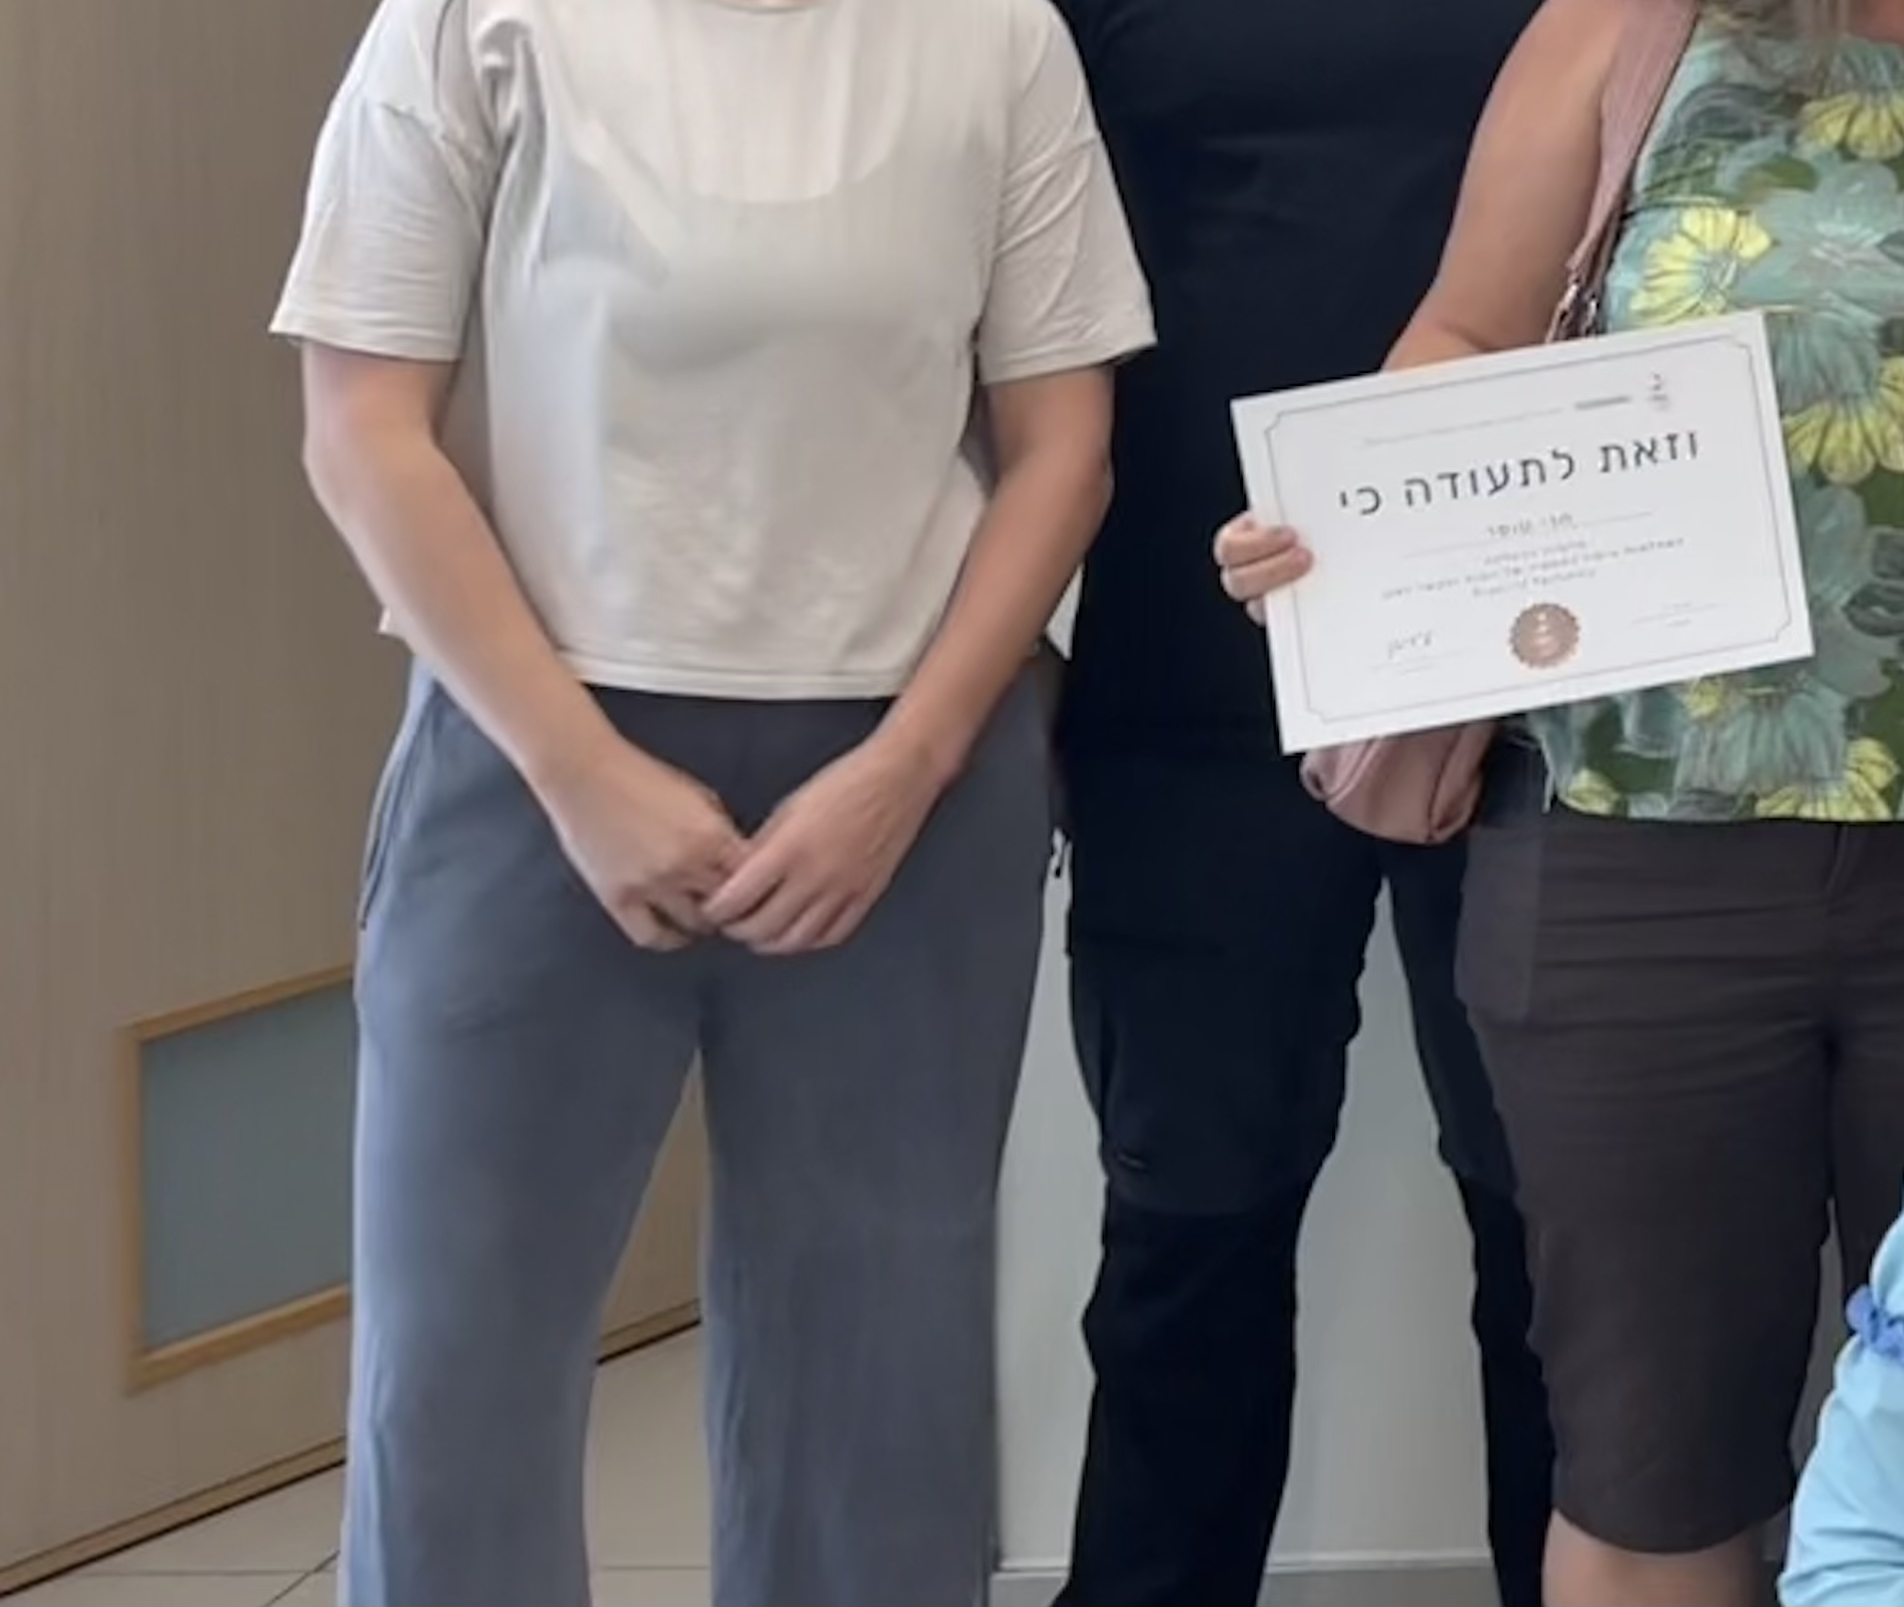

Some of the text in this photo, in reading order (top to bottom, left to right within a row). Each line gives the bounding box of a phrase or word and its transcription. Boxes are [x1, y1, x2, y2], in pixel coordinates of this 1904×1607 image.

[1338, 431, 1699, 516] וזאת לתעודה כי
